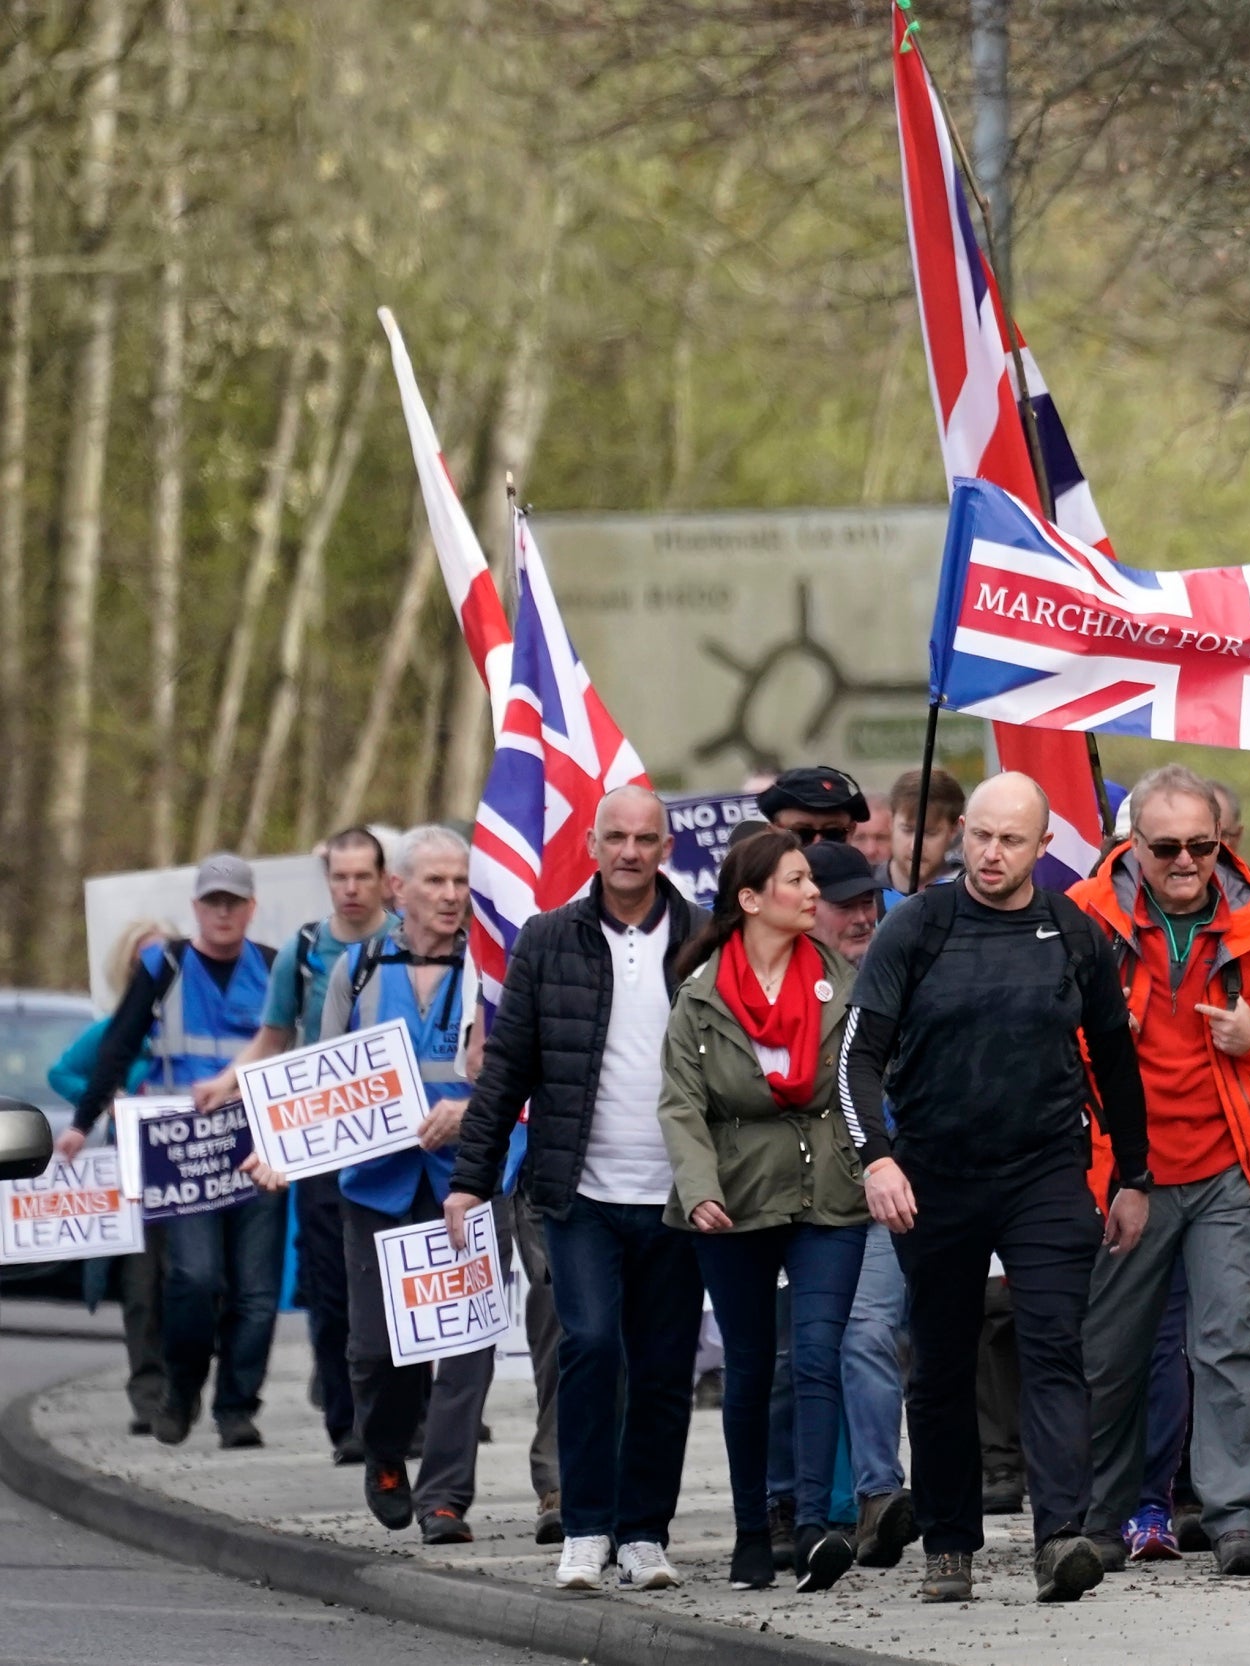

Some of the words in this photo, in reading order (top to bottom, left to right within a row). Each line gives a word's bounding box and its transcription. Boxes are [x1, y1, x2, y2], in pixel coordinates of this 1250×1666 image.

[973, 583, 1169, 645] MARCHING
[1174, 628, 1243, 657] FOR
[670, 804, 717, 833] NO
[262, 1036, 391, 1100] LEAVE
[278, 1075, 390, 1129] MEANS
[148, 1119, 190, 1147] NO
[193, 1108, 248, 1139] DEAL
[186, 1134, 236, 1159] BETTER
[278, 1100, 408, 1165] LEAVE
[177, 1157, 220, 1178] THAN
[19, 1191, 109, 1219] MEANS
[143, 1181, 200, 1208] BAD
[204, 1168, 255, 1200] DEAL
[14, 1215, 119, 1248] LEAVE
[413, 1259, 488, 1305] MEANS
[410, 1290, 500, 1343] LEAVE
